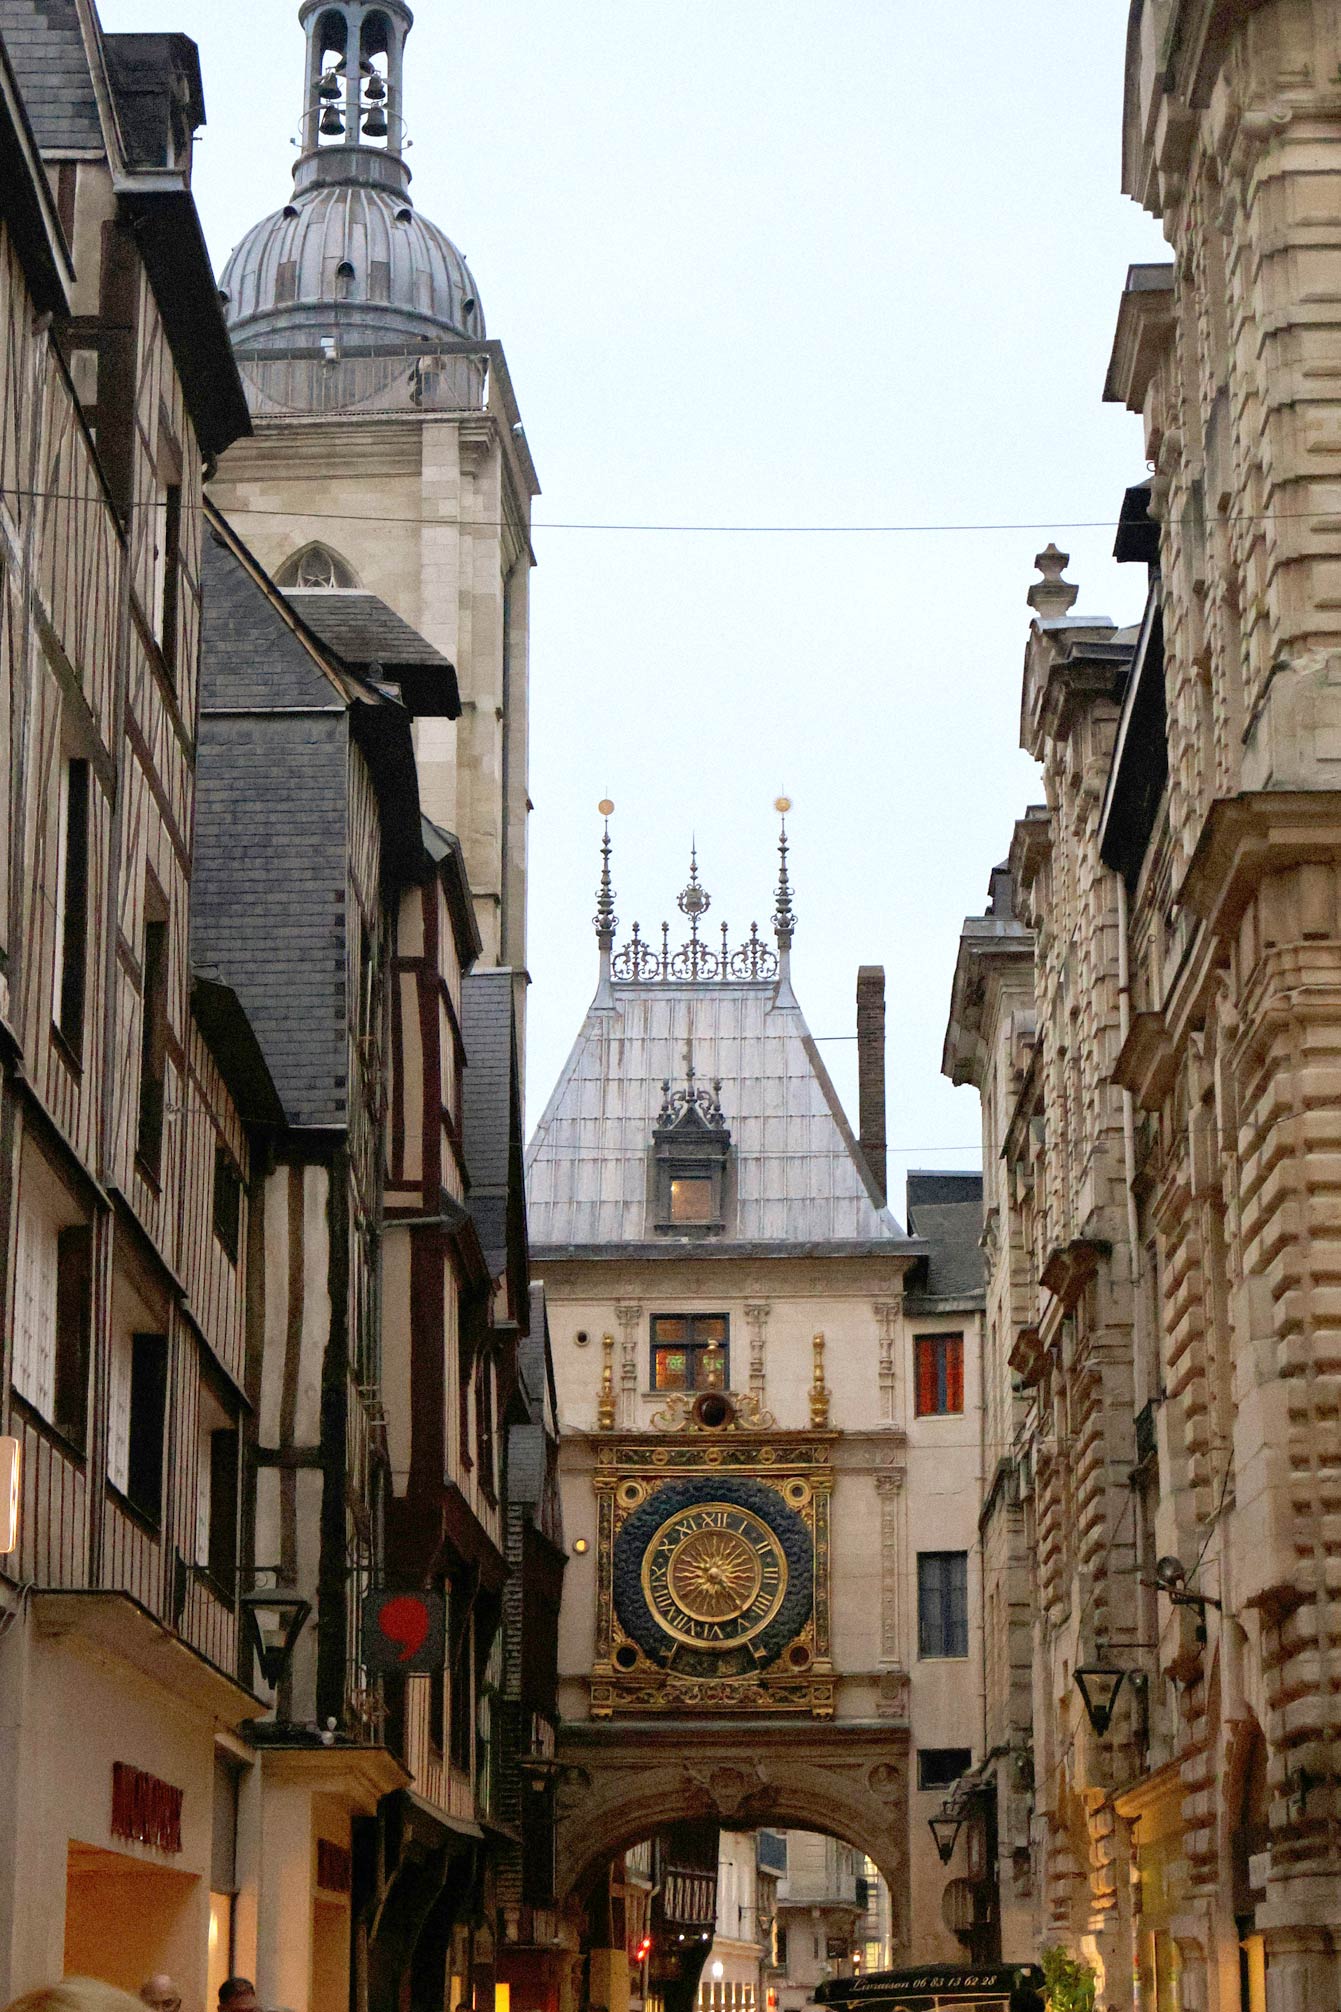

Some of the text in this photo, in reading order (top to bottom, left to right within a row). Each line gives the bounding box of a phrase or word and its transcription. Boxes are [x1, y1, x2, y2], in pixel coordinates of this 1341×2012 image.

[701, 1513, 728, 1528] XII
[738, 1521, 748, 1534] I
[675, 1518, 697, 1540] XI
[657, 1538, 676, 1556] X
[755, 1540, 772, 1555] II
[763, 1567, 779, 1584] III
[704, 1624, 724, 1639] VI
[848, 1975, 997, 1992] Livraison 06 83 13 62 28
